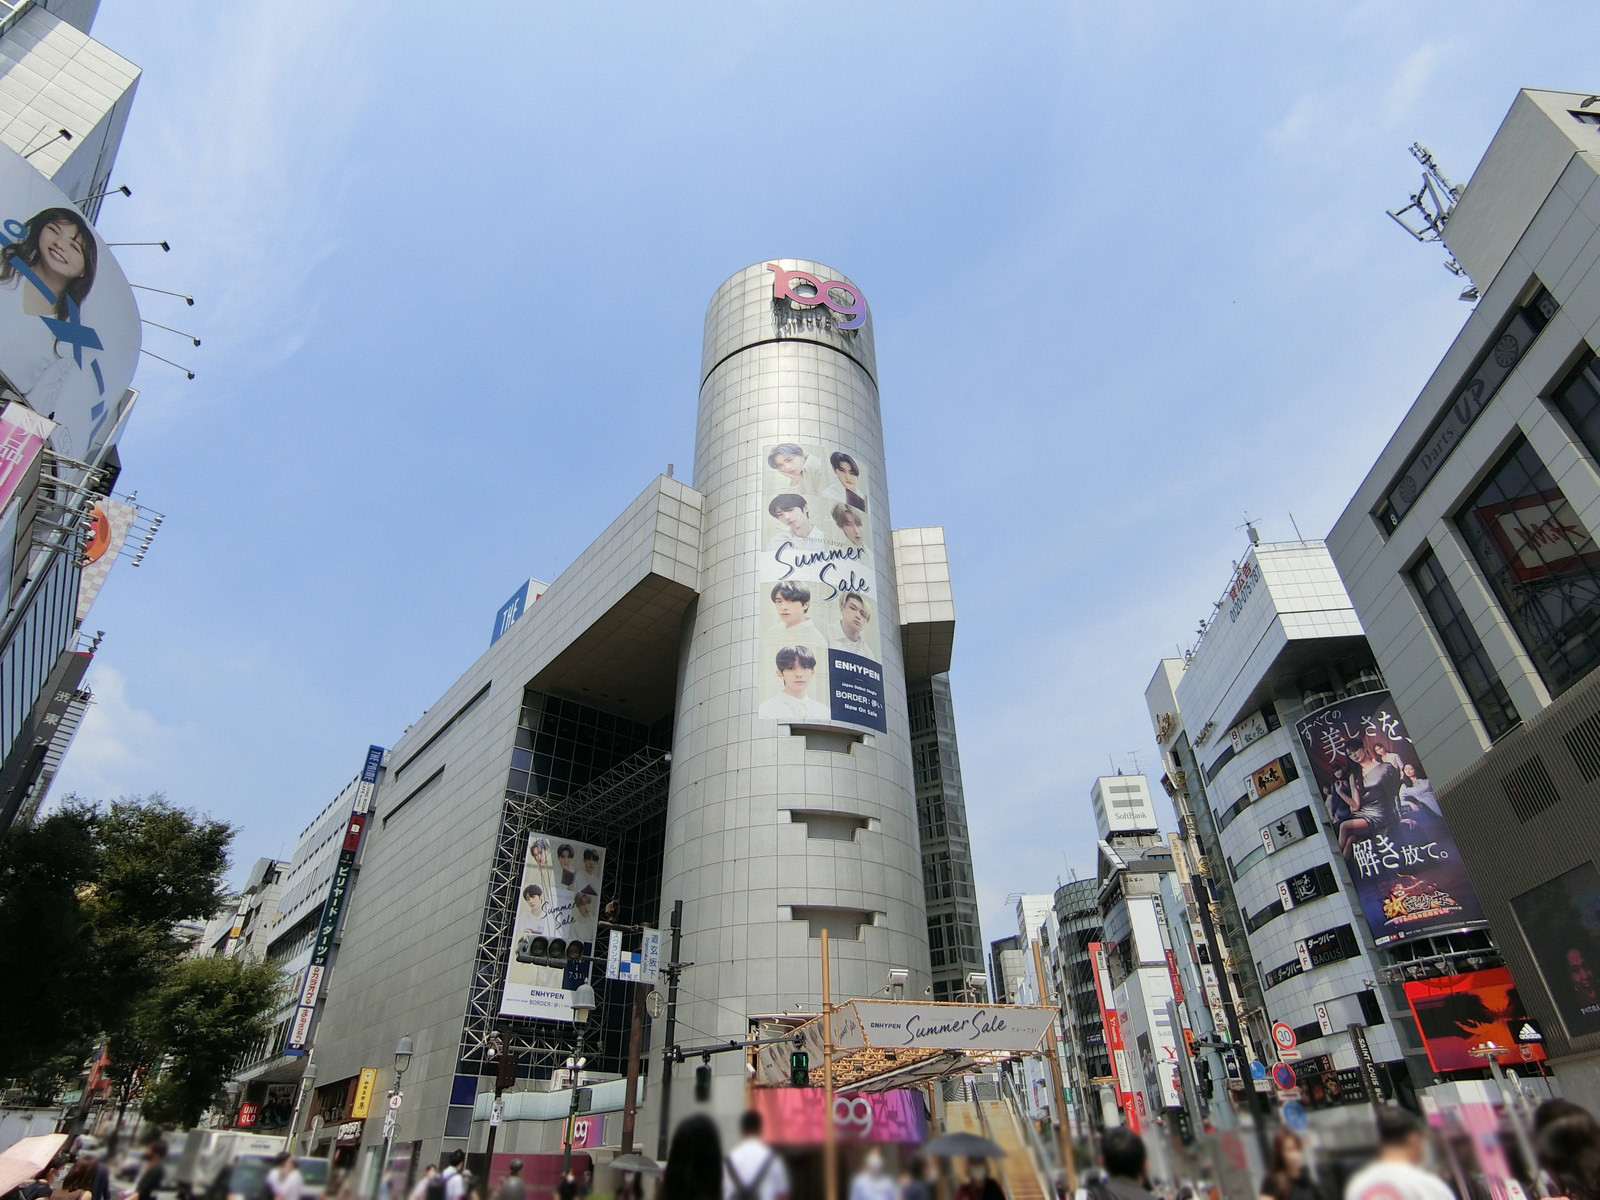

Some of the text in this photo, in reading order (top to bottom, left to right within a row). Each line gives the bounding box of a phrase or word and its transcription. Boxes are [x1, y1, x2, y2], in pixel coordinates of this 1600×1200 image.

[767, 263, 867, 331] 109
[1419, 378, 1486, 473] Darts UP
[774, 541, 865, 581] Summer
[818, 562, 870, 601] Sale
[834, 659, 881, 682] ENHYPEN
[844, 703, 858, 712] Now
[867, 709, 878, 718] Sale
[1301, 709, 1342, 748] すべての
[1320, 710, 1414, 764] 美しさを、
[364, 762, 378, 782] PRIME
[1114, 811, 1147, 820] SoftBank
[1352, 833, 1450, 880] 解き放て。
[317, 866, 350, 956] ビリヤード・ダーツ
[541, 901, 577, 920] Summer
[554, 913, 576, 931] Sale
[1307, 932, 1336, 950] ダーツバー
[314, 957, 325, 965] 3F
[530, 989, 565, 1000] ENHYPEN
[870, 1021, 902, 1030] ENHYPEN
[902, 1014, 970, 1046] Summer
[968, 1009, 1007, 1041] Sale
[1277, 1030, 1291, 1042] 30
[1358, 1038, 1371, 1060] SAINT
[1366, 1063, 1379, 1086] LOUIS
[243, 1105, 258, 1114] UNI
[392, 1097, 398, 1107] 4
[241, 1114, 256, 1124] QLO
